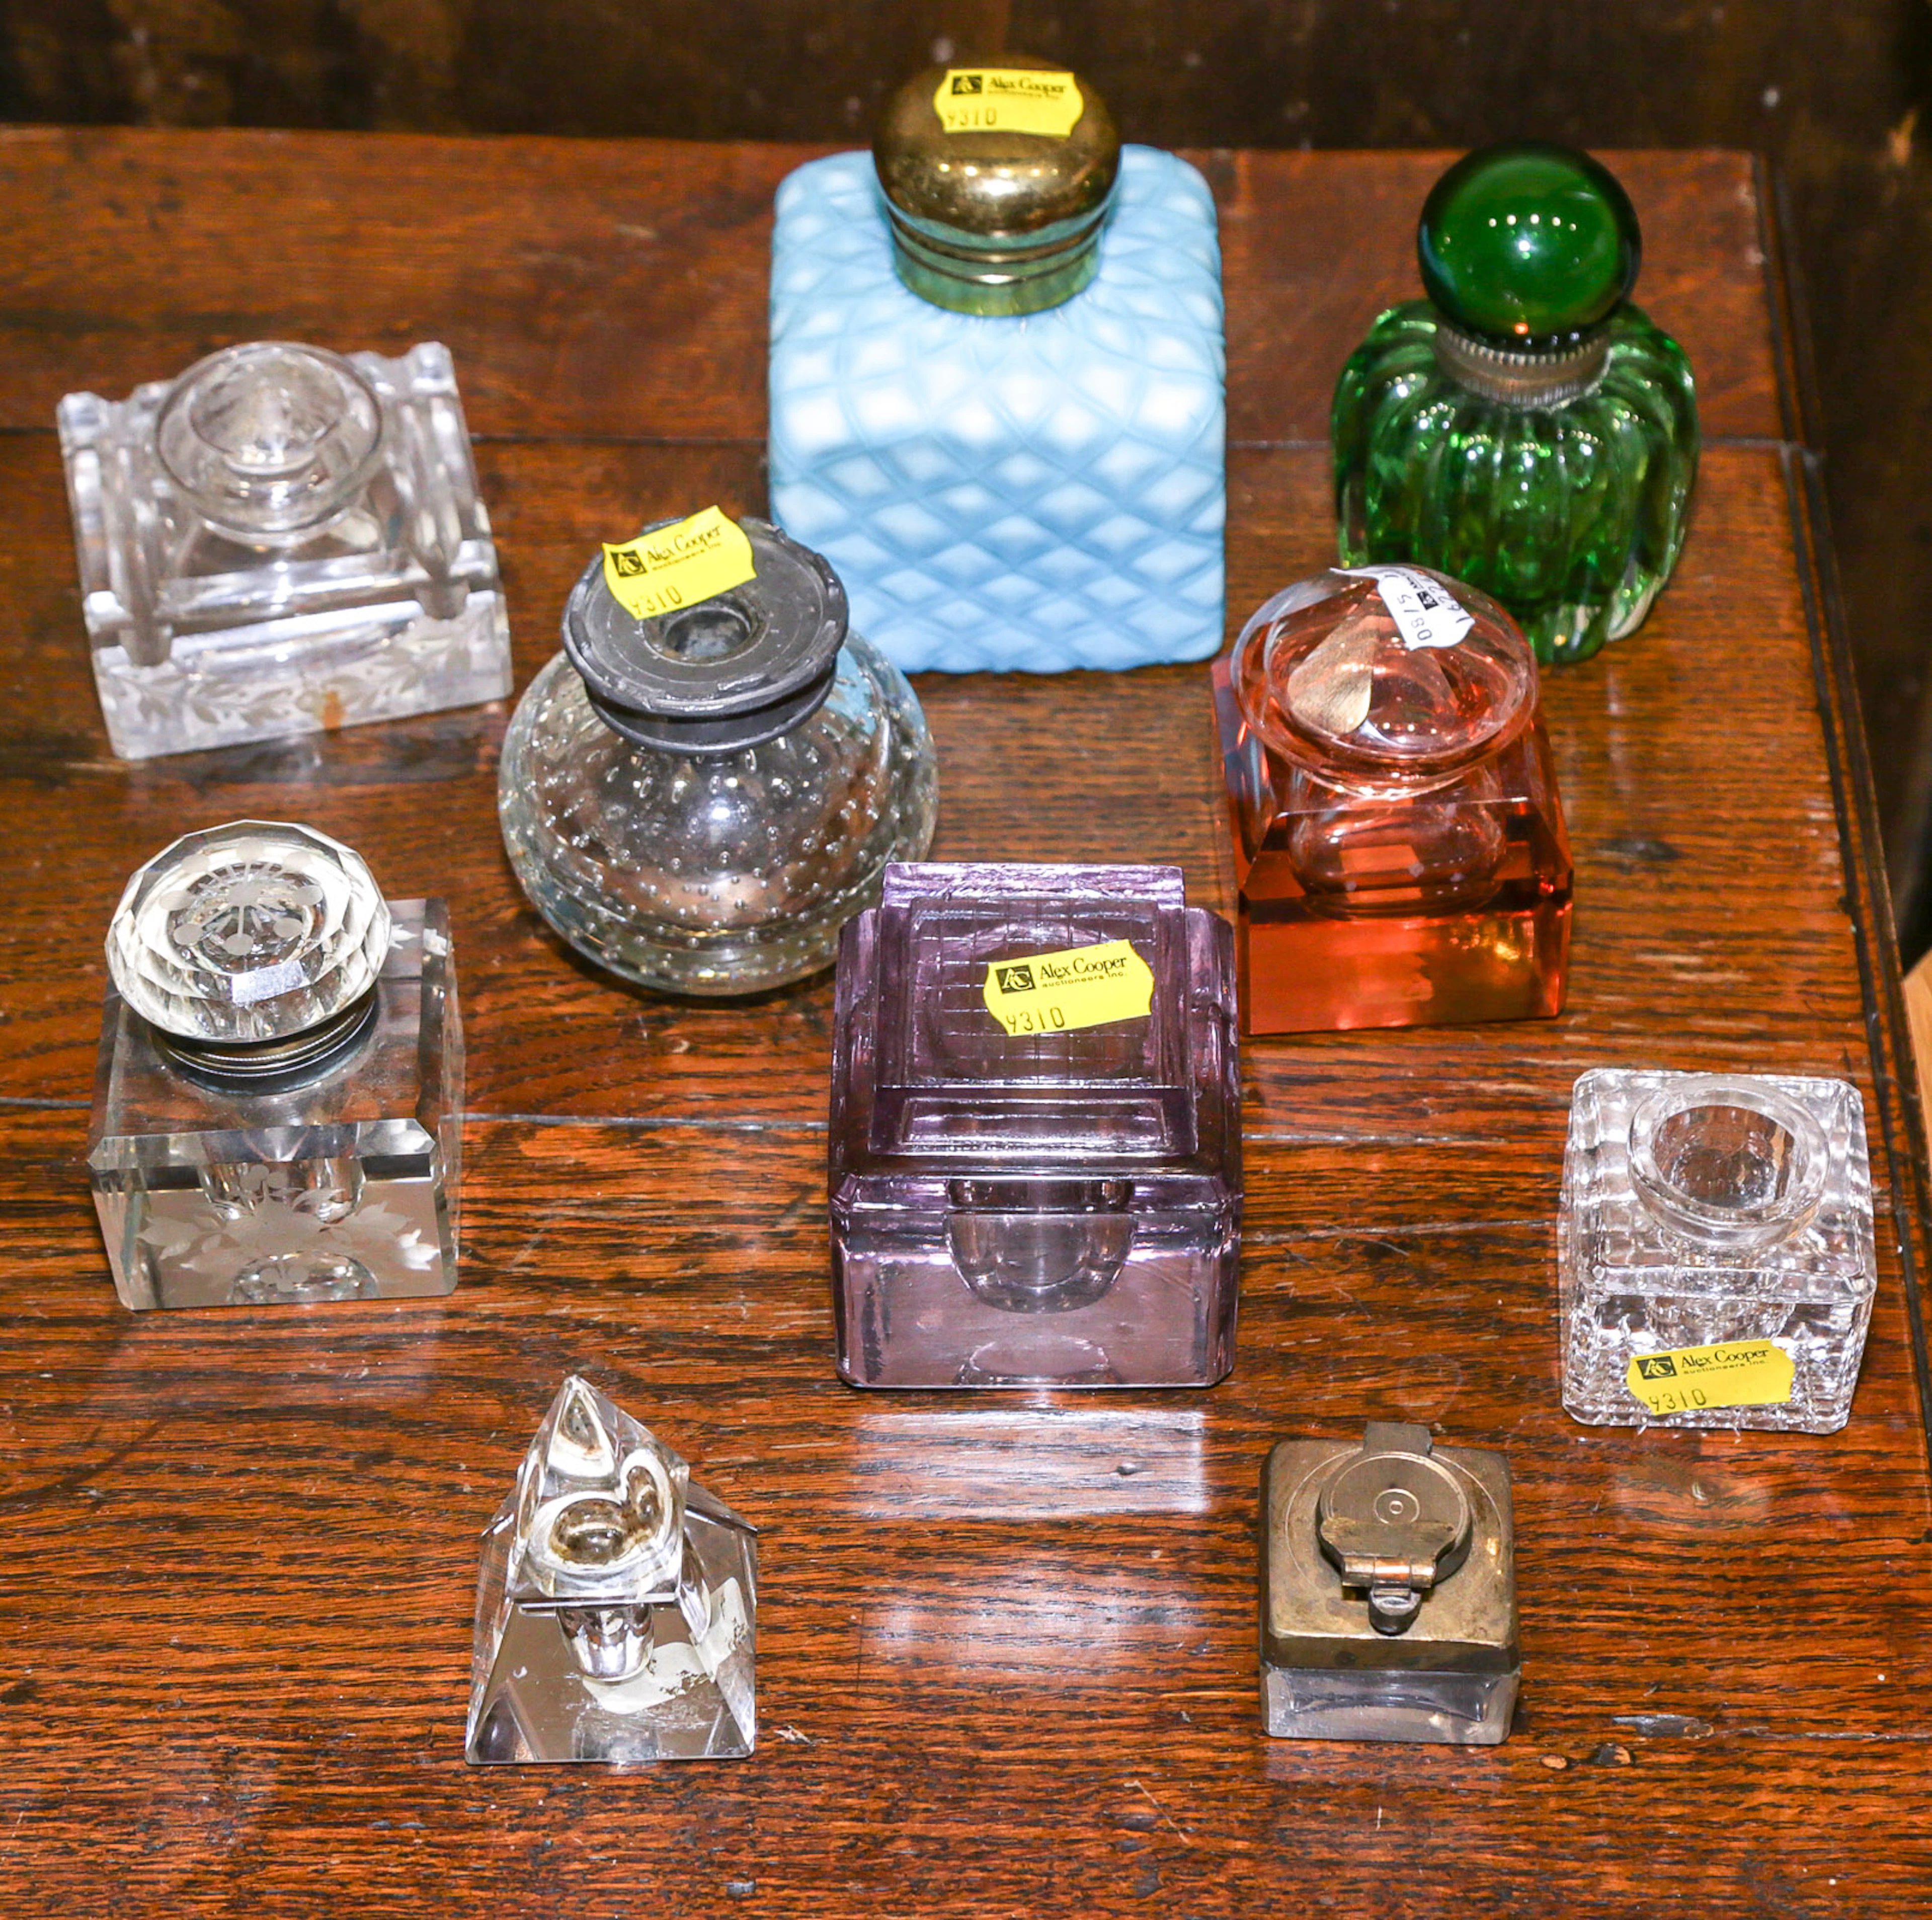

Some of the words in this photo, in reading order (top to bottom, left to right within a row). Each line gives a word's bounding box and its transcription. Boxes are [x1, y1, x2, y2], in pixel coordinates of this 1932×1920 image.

[1040, 963, 1071, 980] Alex
[1073, 957, 1127, 974] Cooper
[1681, 1354, 1713, 1368] Alex
[1715, 1349, 1769, 1363] Cooper
